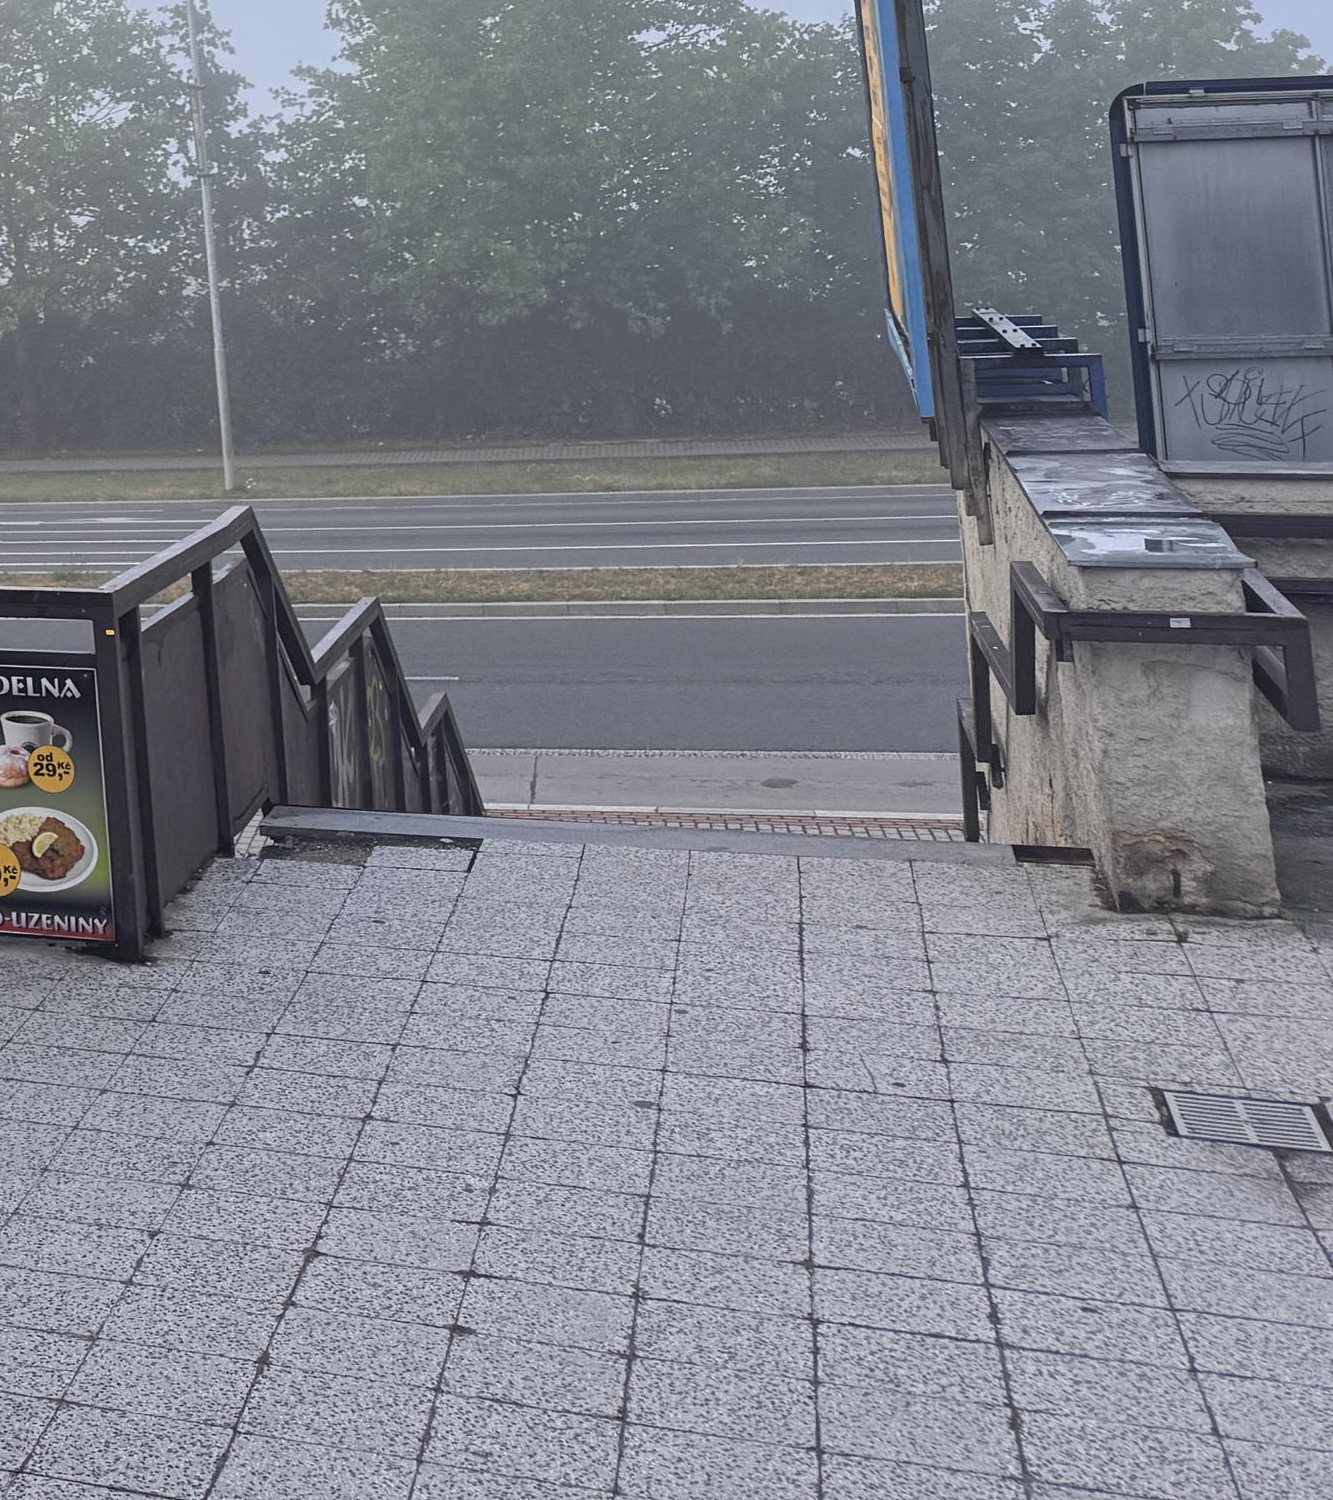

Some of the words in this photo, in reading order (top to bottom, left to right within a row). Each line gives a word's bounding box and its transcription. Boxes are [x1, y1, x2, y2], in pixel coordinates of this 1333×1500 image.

[37, 752, 53, 763] od
[57, 761, 71, 771] Kč
[3, 864, 18, 875] Kč
